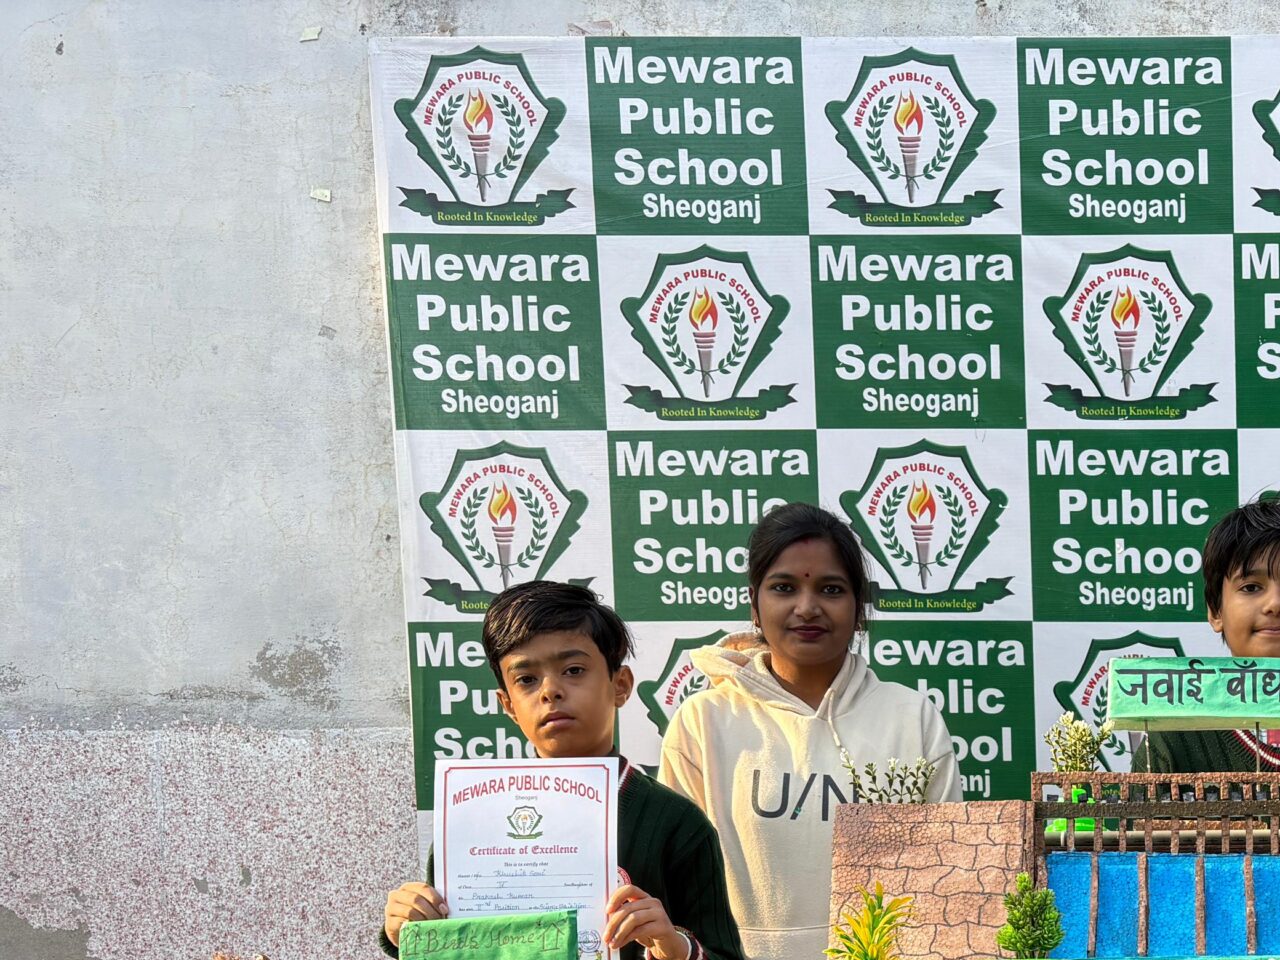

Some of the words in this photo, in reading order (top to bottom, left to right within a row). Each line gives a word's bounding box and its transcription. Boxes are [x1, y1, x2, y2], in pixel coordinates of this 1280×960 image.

[594, 47, 794, 84] Mewara
[1026, 48, 1222, 85] Mewara
[423, 79, 455, 125] MEWARA
[458, 70, 501, 82] PUBLIC
[504, 81, 535, 126] SCHOOL
[854, 79, 887, 127] MEWARA
[889, 72, 932, 83] PUBLIC
[935, 82, 966, 128] SCHOOL
[619, 98, 774, 135] Public
[1049, 99, 1201, 135] Public
[614, 148, 782, 185] School
[1042, 149, 1208, 186] School
[438, 212, 471, 222] Rooted
[474, 212, 483, 222] In
[486, 212, 538, 224] Knowledge
[643, 193, 761, 224] Sheoganj
[1069, 194, 1185, 223] Sheoganj
[391, 244, 590, 282] Mewara
[818, 245, 1013, 281] Mewara
[648, 277, 682, 323] MEWARA
[684, 268, 728, 281] PUBLIC
[728, 278, 761, 322] SCHOOL
[1071, 276, 1105, 321] MEWARA
[1107, 267, 1150, 279] PUBLIC
[1151, 276, 1183, 322] SCHOOL
[416, 294, 571, 332] Public
[842, 295, 993, 331] Public
[412, 344, 580, 381] School
[836, 344, 1000, 380] School
[441, 388, 559, 419] Sheoganj
[863, 388, 978, 417] Sheoganj
[616, 441, 809, 476] Mewara
[1036, 440, 1229, 476] Mewara
[448, 472, 481, 517] MEWARA
[483, 464, 525, 475] PUBLIC
[527, 473, 560, 518] SCHOOL
[867, 470, 901, 516] MEWARA
[902, 463, 946, 475] PUBLIC
[946, 472, 978, 516] SCHOOL
[1059, 489, 1209, 525] Public
[633, 538, 749, 574] Scho
[1052, 538, 1202, 574] Schoo
[461, 600, 489, 610] Roote
[661, 581, 751, 610] Sheoga
[880, 599, 912, 608] Rooted
[914, 599, 924, 608] In
[927, 599, 976, 611] Knowledge
[1080, 582, 1193, 610] Sheoganj
[917, 679, 1005, 714] blic
[1115, 659, 1216, 705] जवाई
[453, 778, 505, 805] MEWARA
[508, 776, 550, 791] PUBLIC
[554, 777, 603, 803] SCHOOL
[469, 847, 516, 856] Certificate
[519, 846, 528, 854] of
[531, 845, 578, 854] Excellence
[483, 930, 535, 948] Home
